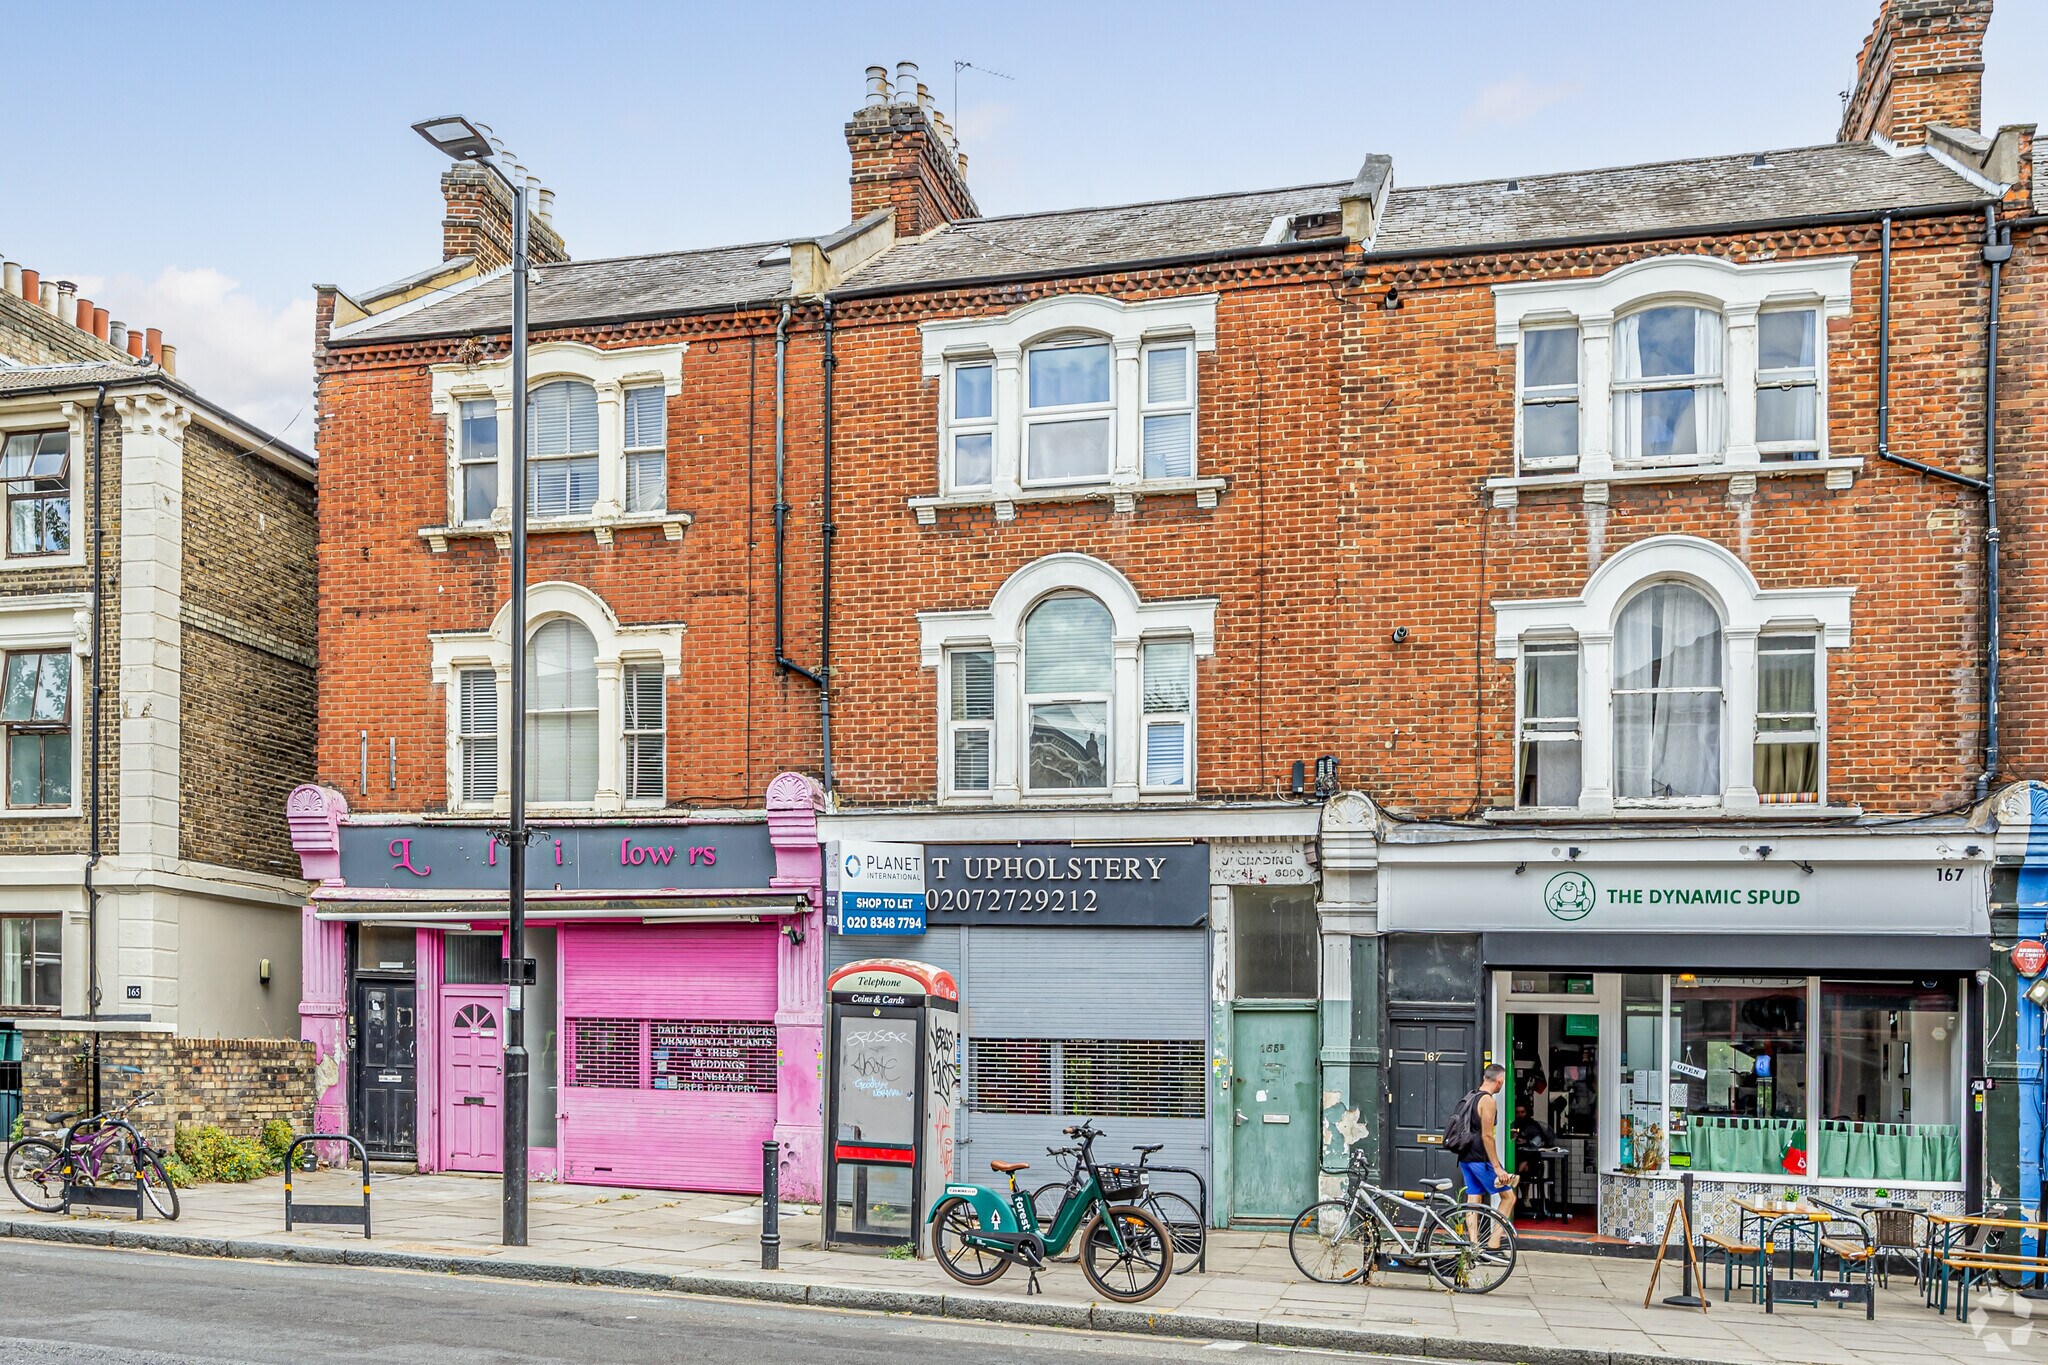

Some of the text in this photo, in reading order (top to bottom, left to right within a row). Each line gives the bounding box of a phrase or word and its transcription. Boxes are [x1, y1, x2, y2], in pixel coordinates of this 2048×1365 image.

[388, 838, 431, 876] L
[554, 839, 563, 865] i
[866, 855, 920, 871] PLANET
[931, 857, 1166, 880] T UPHOLSTERY
[866, 872, 921, 881] INTERNATIONAL
[1936, 868, 1964, 882] 167
[925, 888, 1098, 912] 02072729212
[1607, 889, 1801, 905] THE DYNAMIC SPUD
[856, 898, 913, 908] SHOP TO LET
[847, 916, 867, 928] 020
[870, 917, 895, 929] 8348
[897, 917, 922, 929] 7794
[858, 976, 902, 988] Telephone
[128, 987, 140, 997] 165
[851, 994, 905, 1005] Coins & Cards
[658, 1026, 776, 1036] DAILY FRESH FLOWERS
[660, 1037, 773, 1047] ORNAMENTAL PLANTS
[695, 1048, 739, 1057] & TREES
[1424, 1051, 1442, 1062] 167
[690, 1059, 746, 1069] WEDDINGS
[1677, 1063, 1700, 1075] OPEN
[691, 1072, 745, 1081] FUNERALS
[678, 1083, 758, 1093] FREE DELIVERY
[1015, 1196, 1032, 1231] forest
